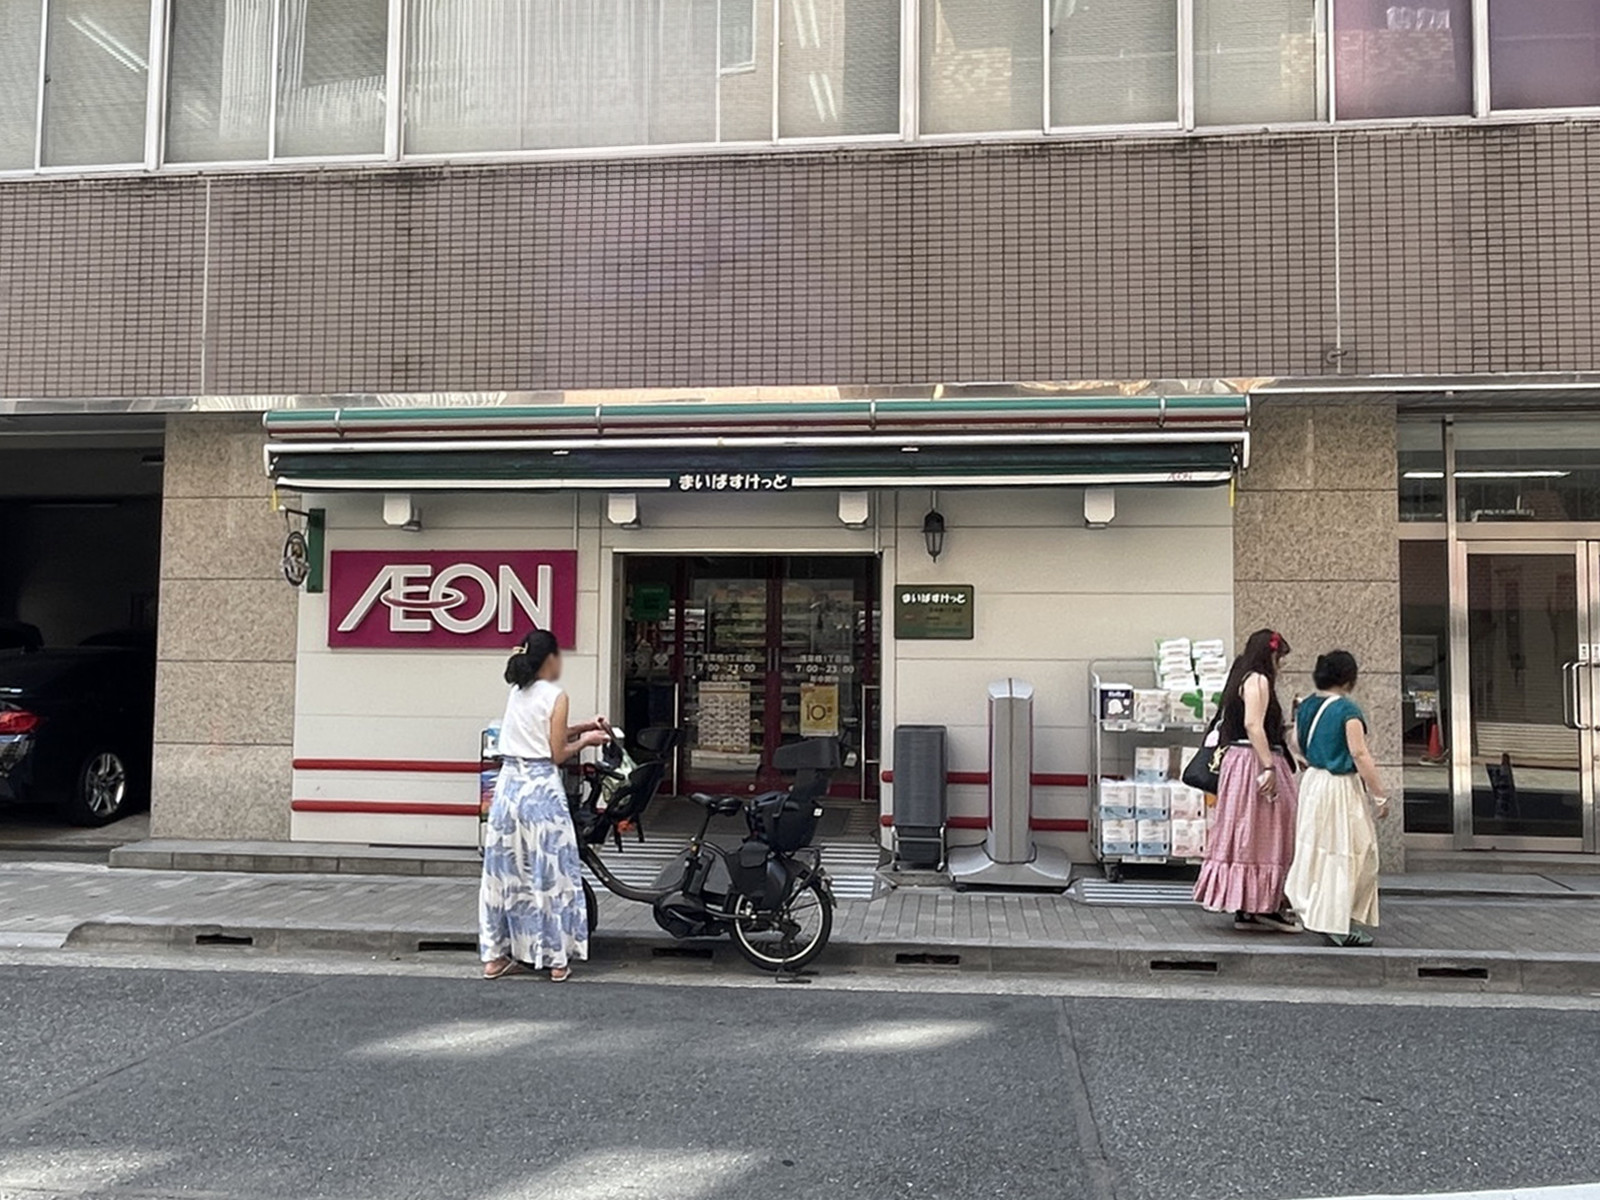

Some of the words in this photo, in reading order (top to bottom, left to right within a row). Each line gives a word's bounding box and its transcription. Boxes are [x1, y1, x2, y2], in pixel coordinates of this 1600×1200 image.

[679, 474, 788, 490] まいばすけっと
[337, 563, 553, 633] AEON
